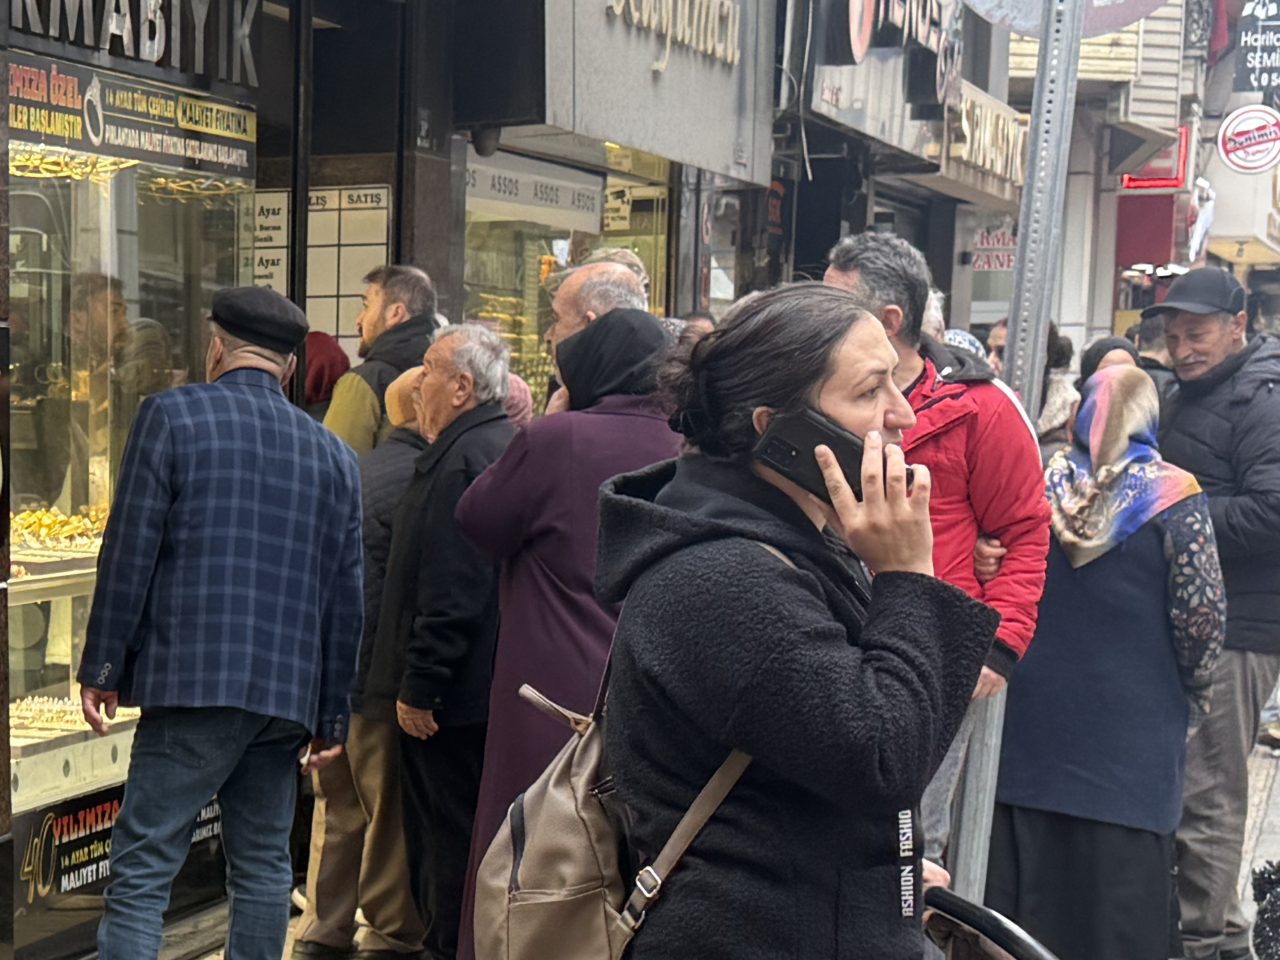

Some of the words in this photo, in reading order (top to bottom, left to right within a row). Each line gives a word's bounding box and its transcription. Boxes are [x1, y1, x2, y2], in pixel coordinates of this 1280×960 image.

[347, 193, 382, 206] SATIŞ
[258, 205, 282, 219] Ayar
[257, 256, 281, 269] Ayar
